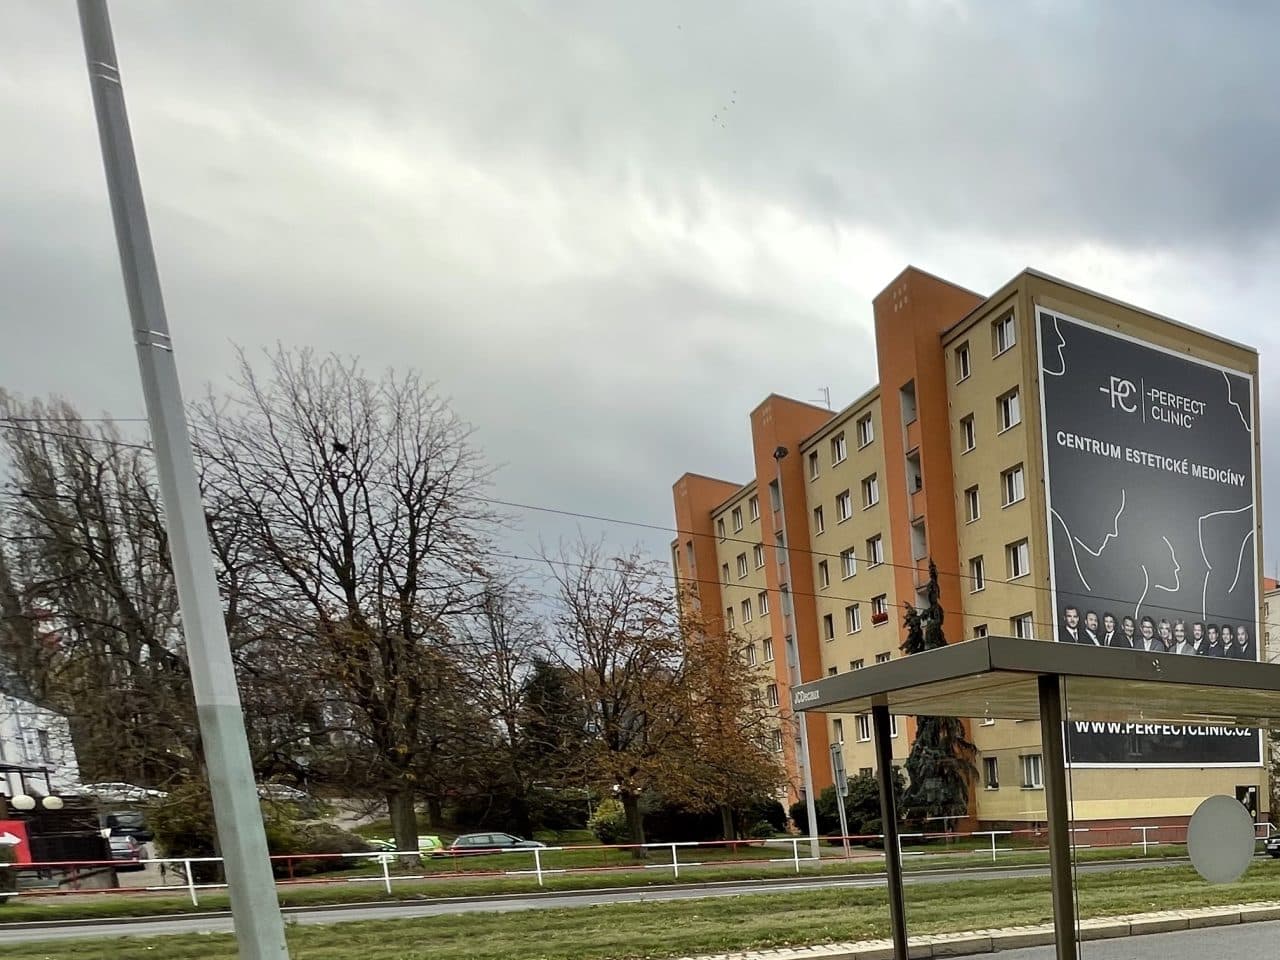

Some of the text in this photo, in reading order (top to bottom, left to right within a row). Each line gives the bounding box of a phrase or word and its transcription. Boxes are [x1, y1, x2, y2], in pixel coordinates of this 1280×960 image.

[1151, 405, 1194, 429] CLINIC
[1056, 430, 1246, 487] CENTRUM ESTETICKÉ MEDICÍNY
